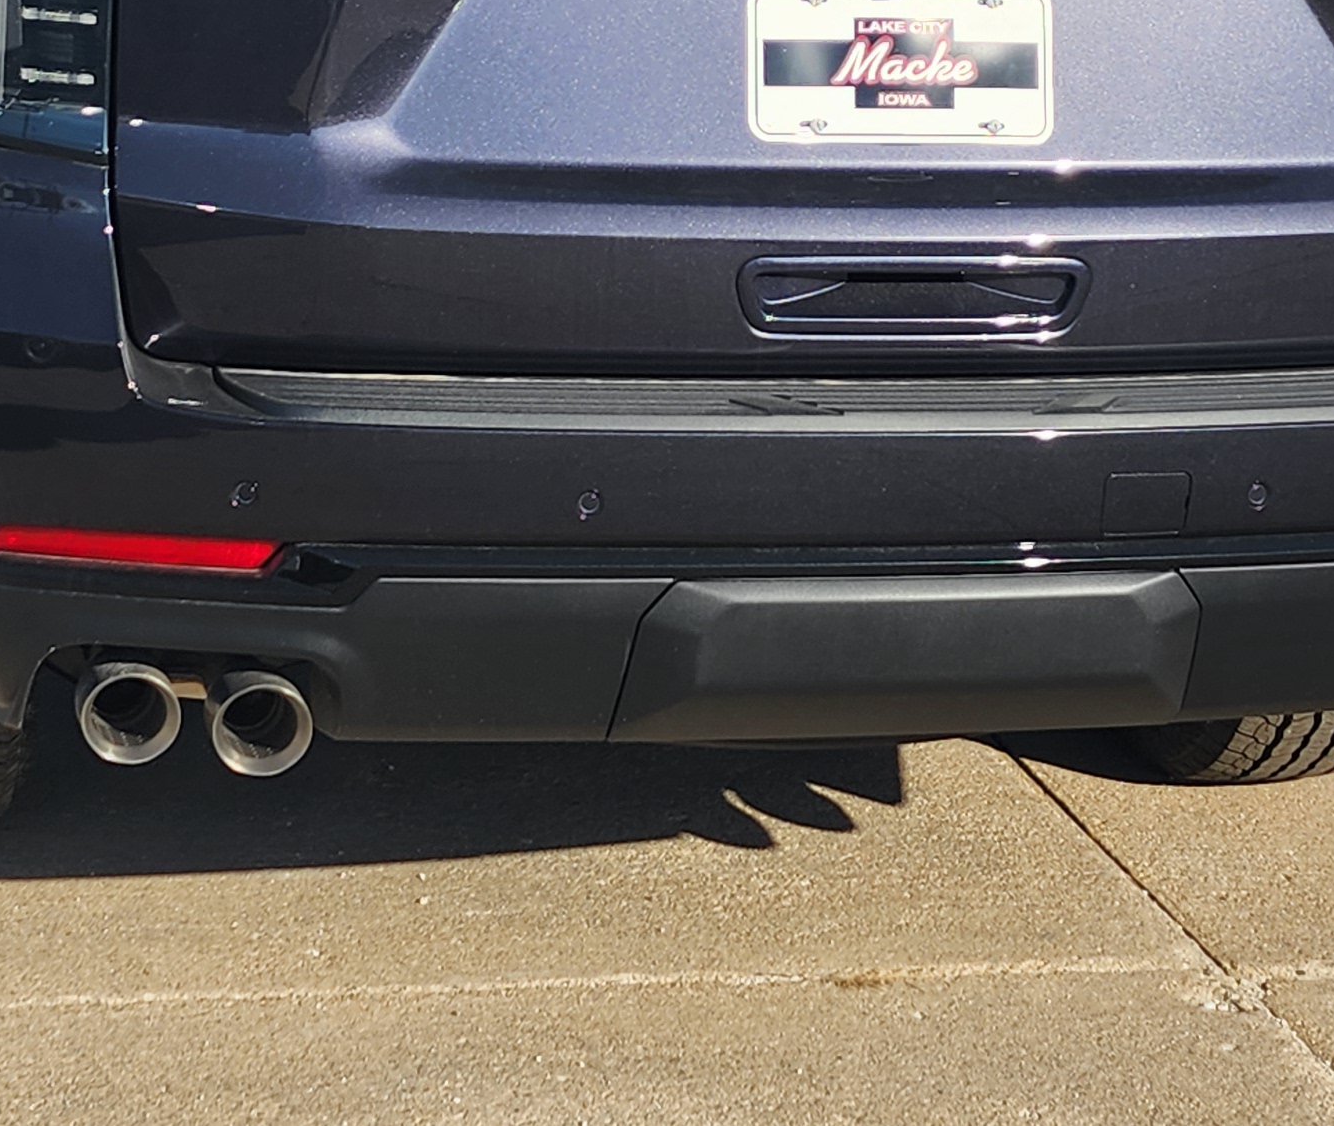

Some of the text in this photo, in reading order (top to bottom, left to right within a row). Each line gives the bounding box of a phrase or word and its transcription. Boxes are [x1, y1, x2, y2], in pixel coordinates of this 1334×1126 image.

[857, 20, 948, 35] LAKE CITY
[831, 35, 979, 86] Macke
[877, 91, 933, 107] IOWA
